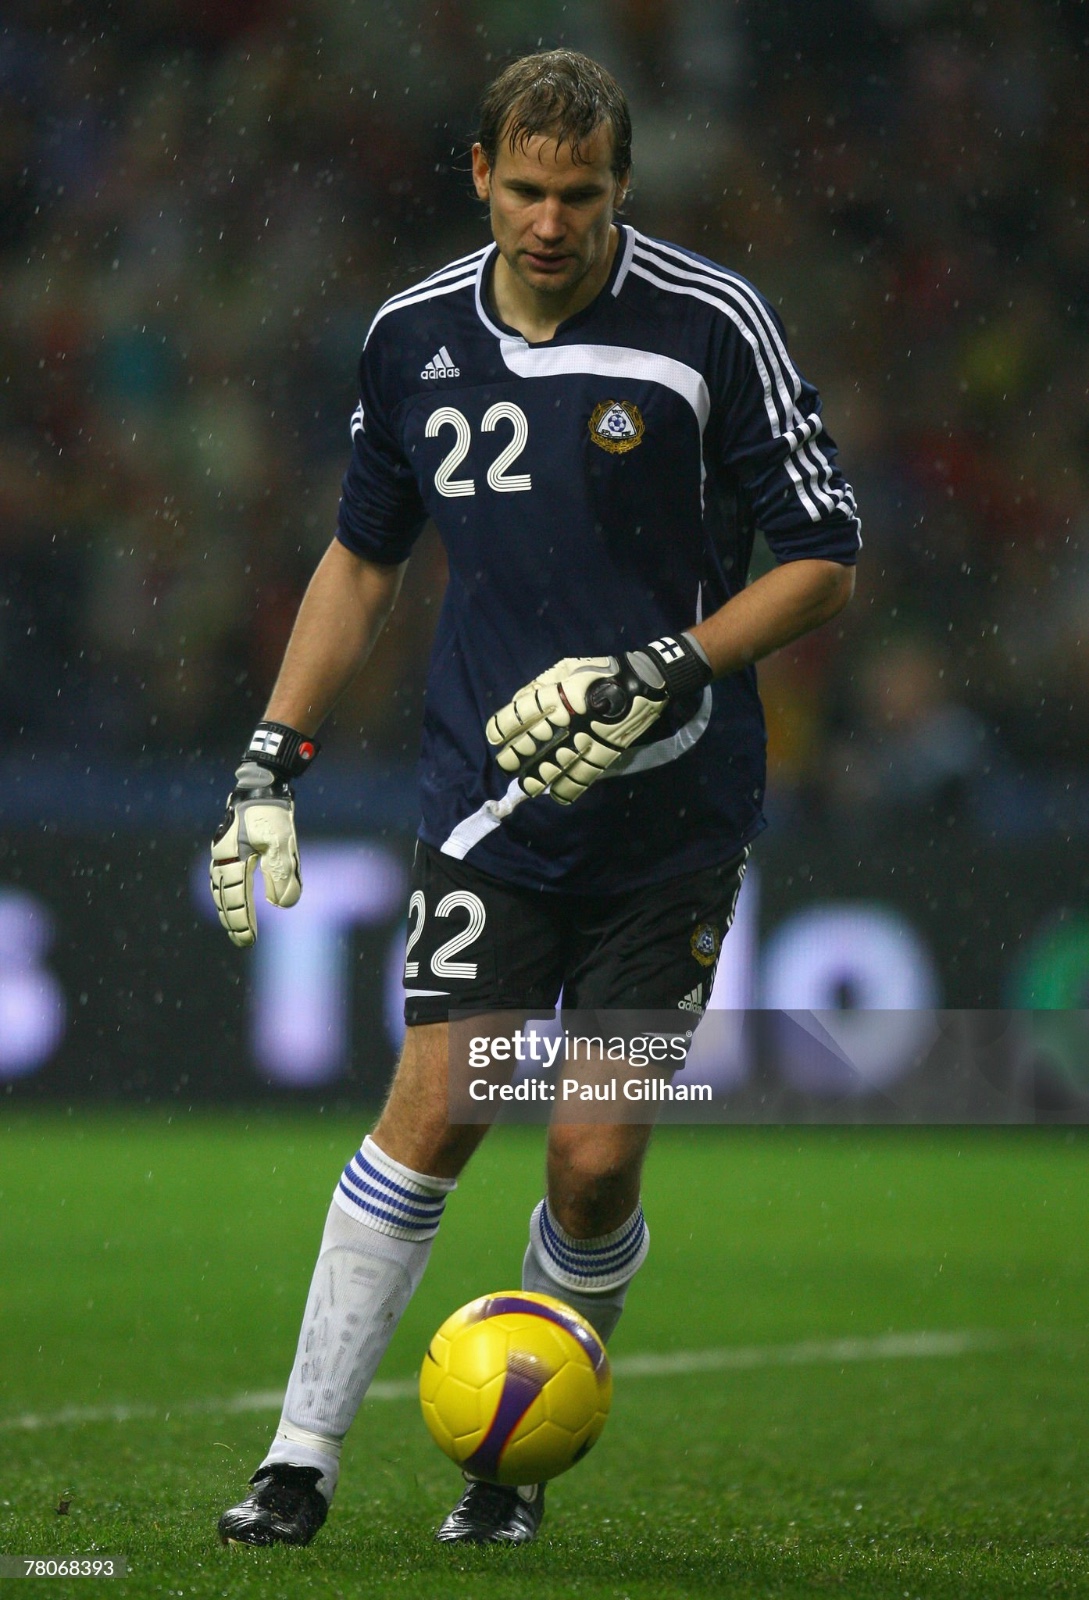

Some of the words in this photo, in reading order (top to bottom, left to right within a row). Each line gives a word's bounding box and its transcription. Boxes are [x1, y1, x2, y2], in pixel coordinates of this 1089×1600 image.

[420, 366, 460, 380] adidas
[424, 401, 532, 497] 22
[404, 889, 486, 979] 22
